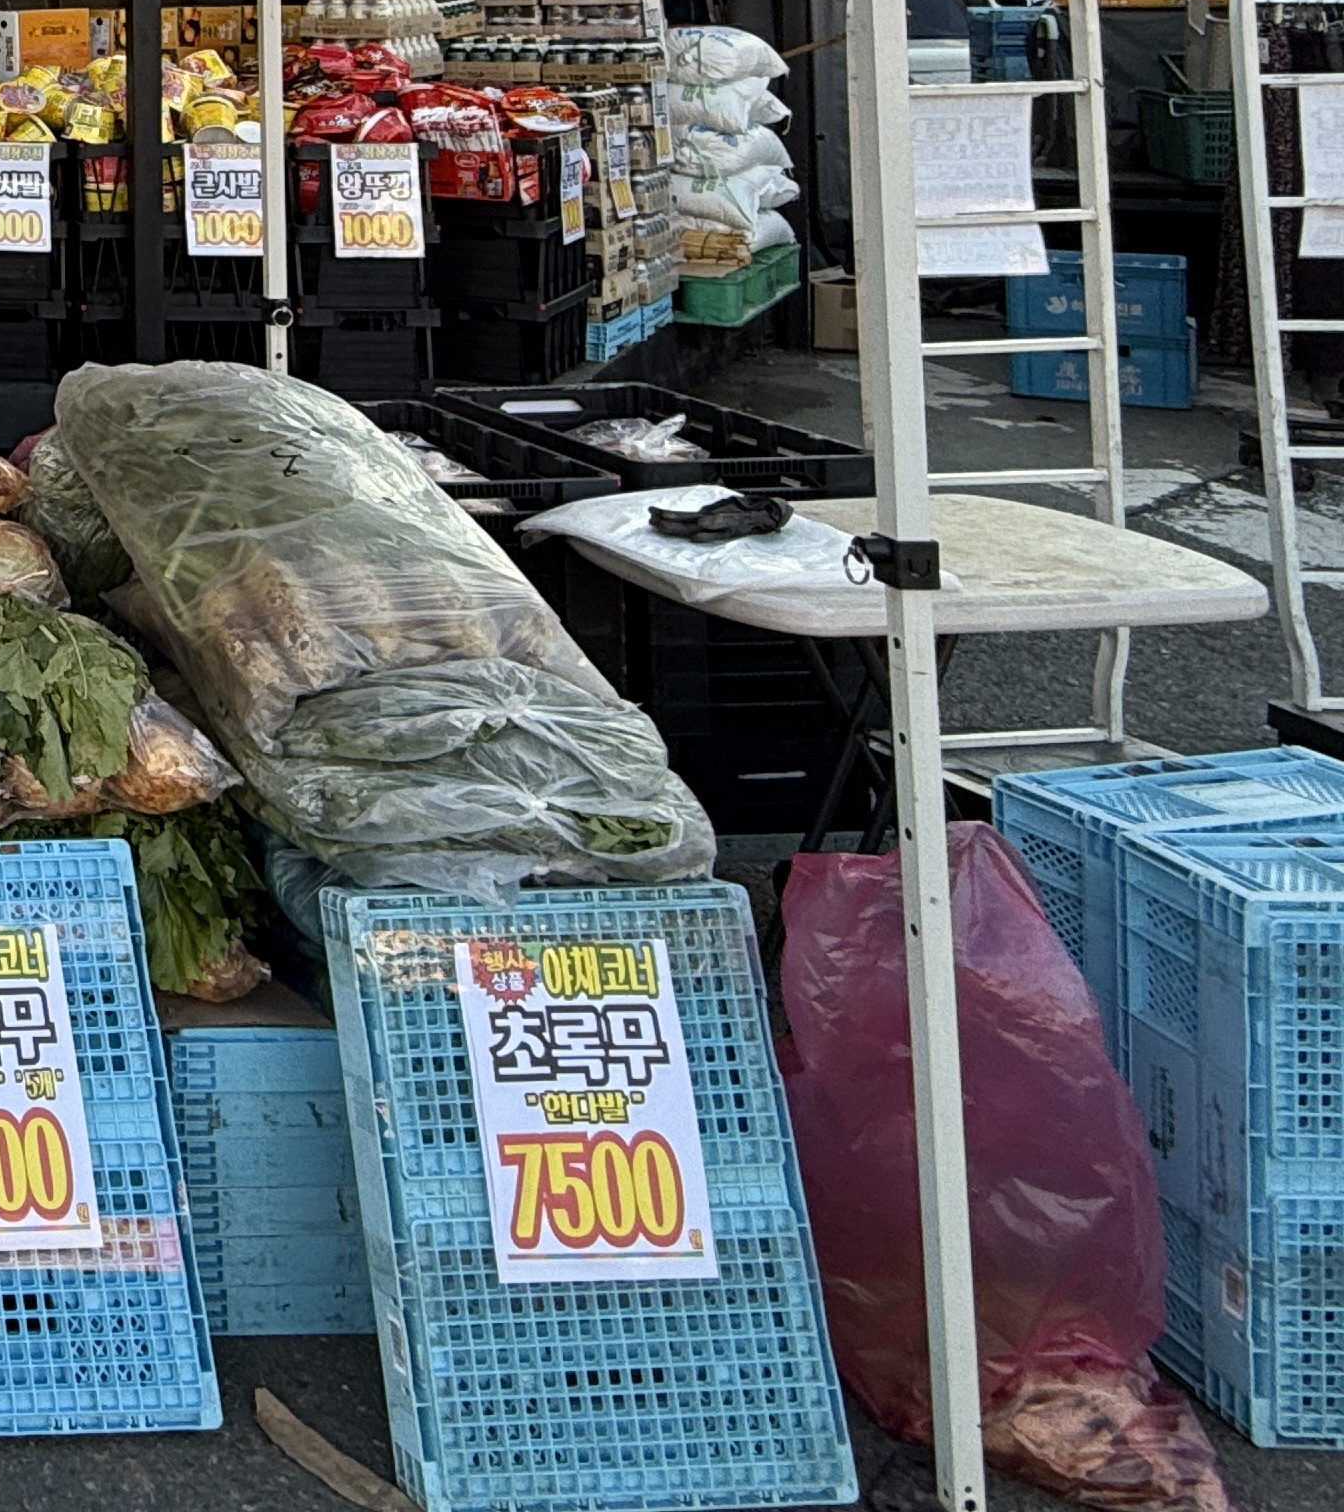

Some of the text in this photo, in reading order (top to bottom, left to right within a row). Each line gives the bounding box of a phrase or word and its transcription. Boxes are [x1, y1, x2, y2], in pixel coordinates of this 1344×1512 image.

[191, 170, 261, 199] 큰사발
[337, 171, 412, 201] 왕뚜껑
[191, 210, 262, 245] 1000
[339, 212, 414, 248] 1000
[482, 943, 659, 999] 행사 야채코너
[491, 972, 525, 990] 상품
[489, 1003, 670, 1086] 초록무
[497, 1129, 685, 1250] 7500
